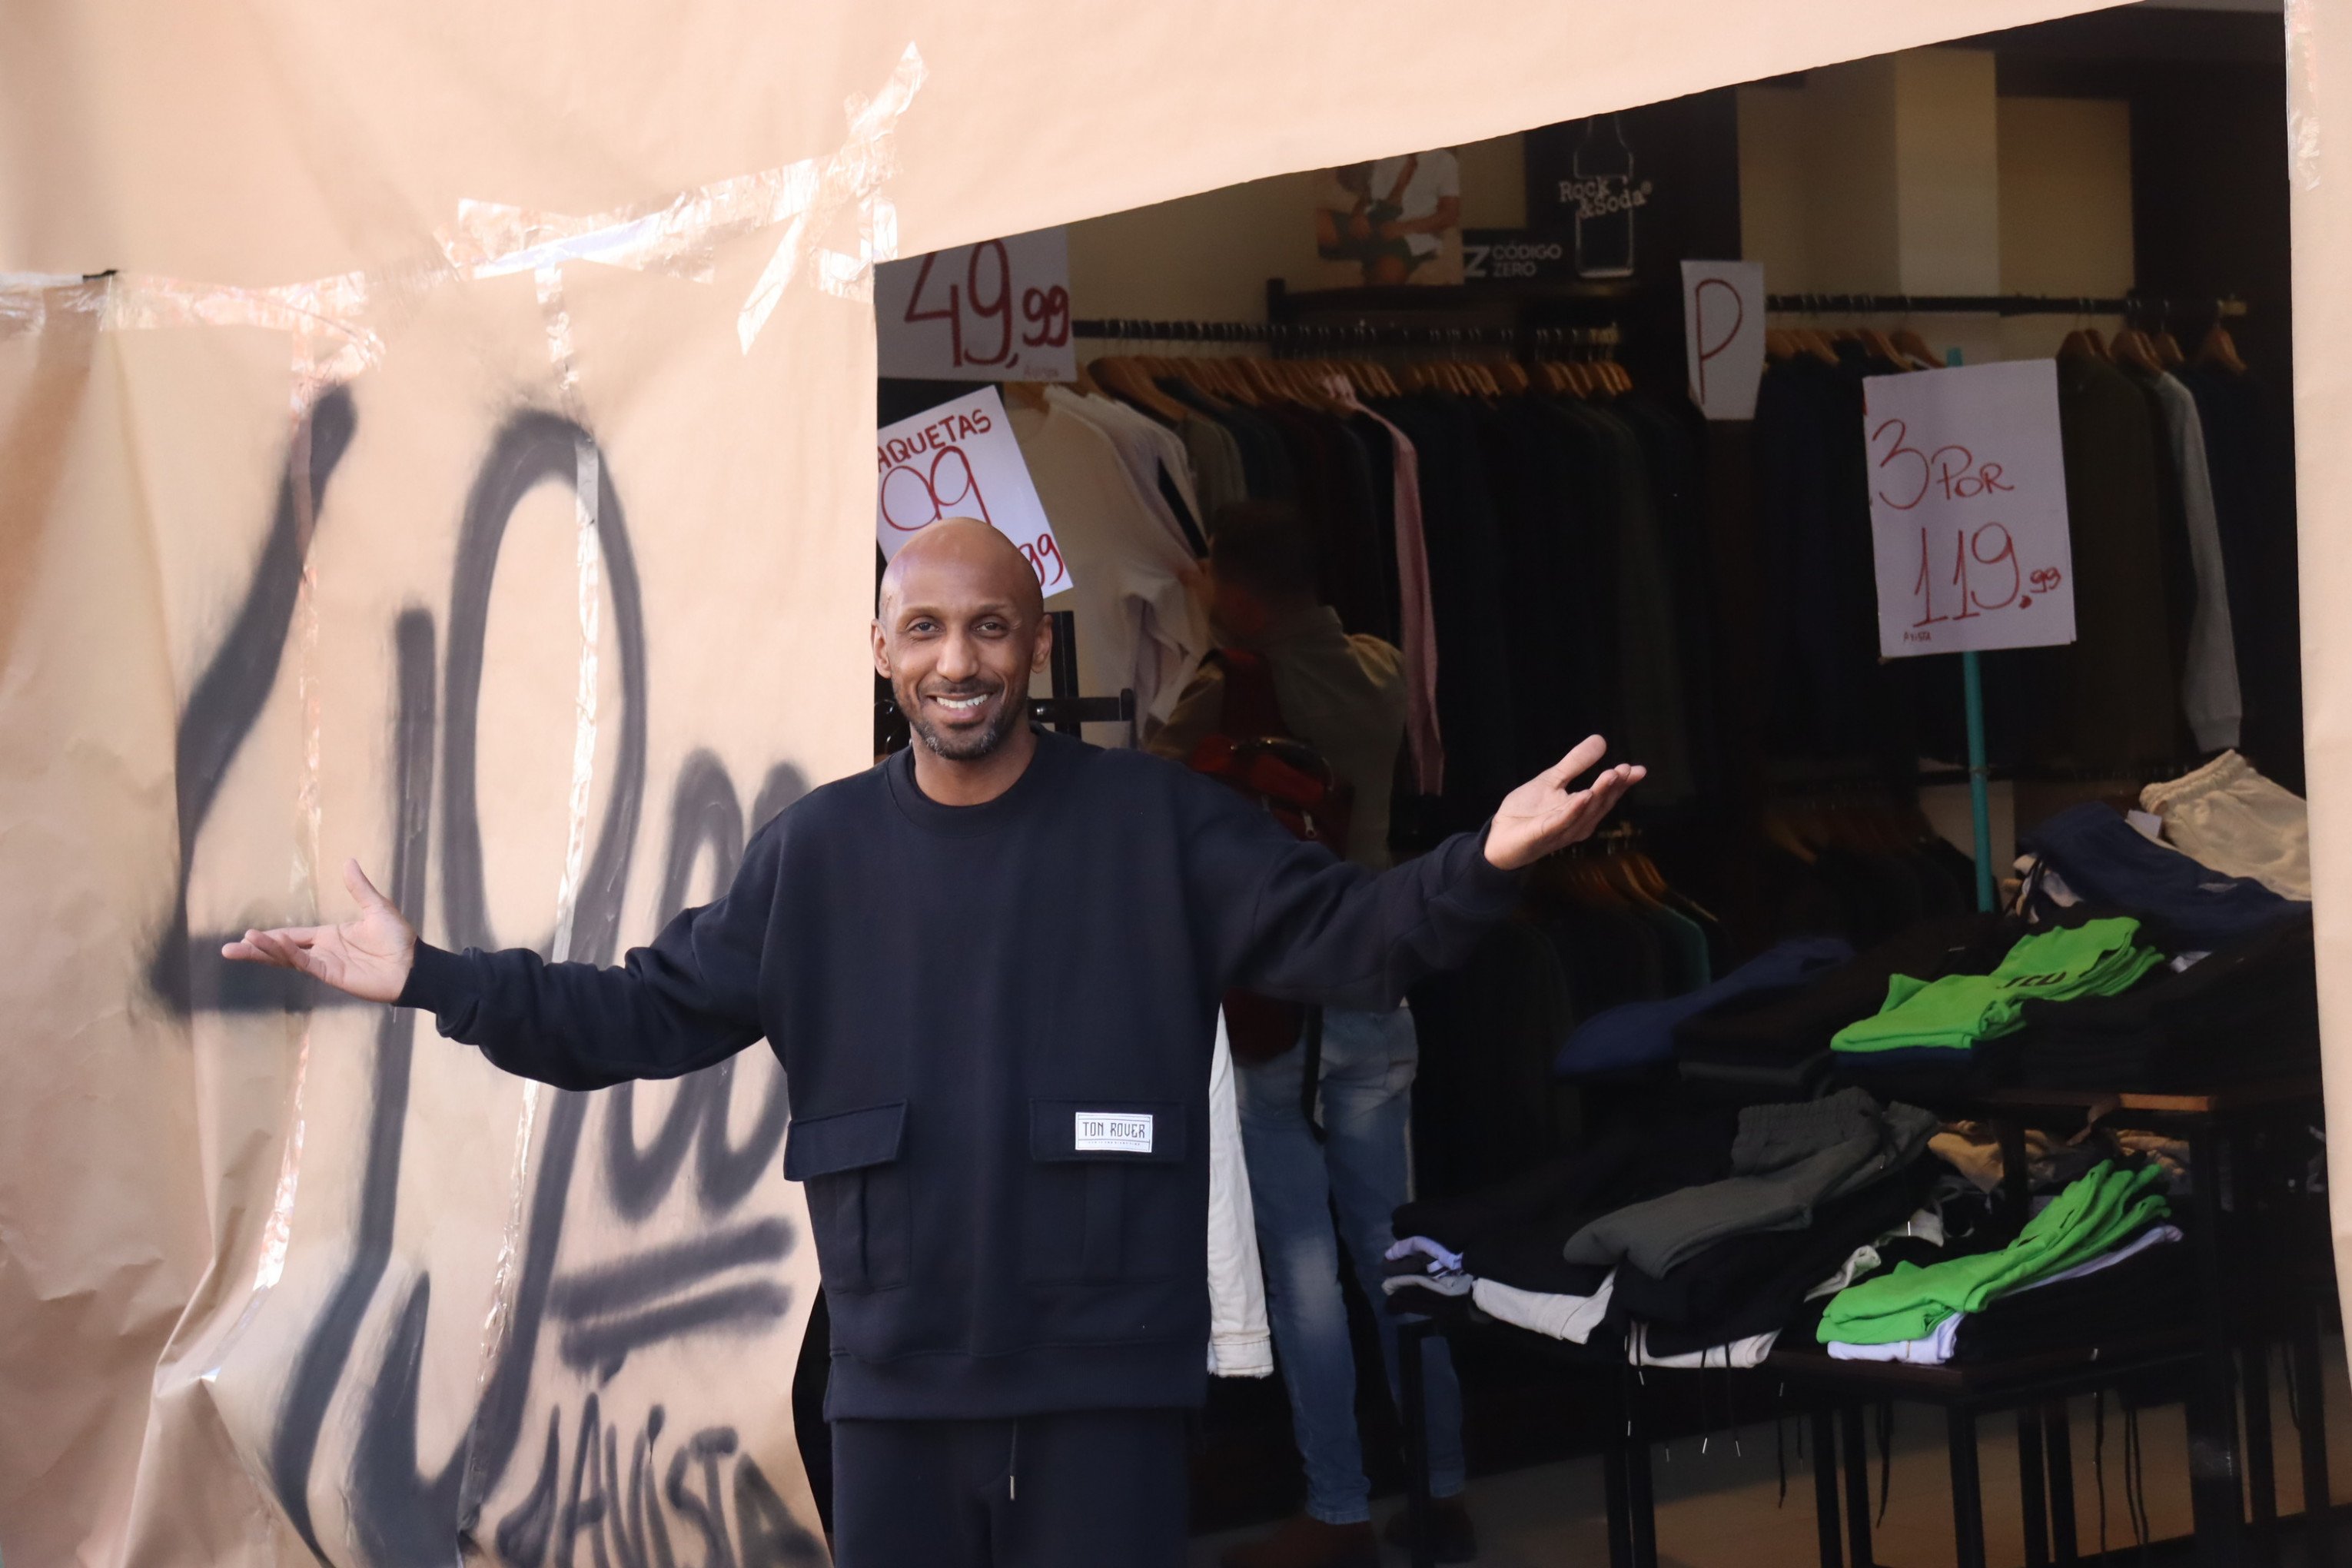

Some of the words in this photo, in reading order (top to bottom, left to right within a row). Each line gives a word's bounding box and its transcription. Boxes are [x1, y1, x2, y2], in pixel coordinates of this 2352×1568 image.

[1558, 177, 1610, 203] Rock
[1493, 241, 1563, 260] CÓDIGO
[1493, 261, 1537, 277] ZERO
[1696, 278, 1743, 404] P
[1872, 419, 1929, 510] 3
[1082, 1121, 1105, 1137] TON
[1110, 1122, 1145, 1138] ROVER
